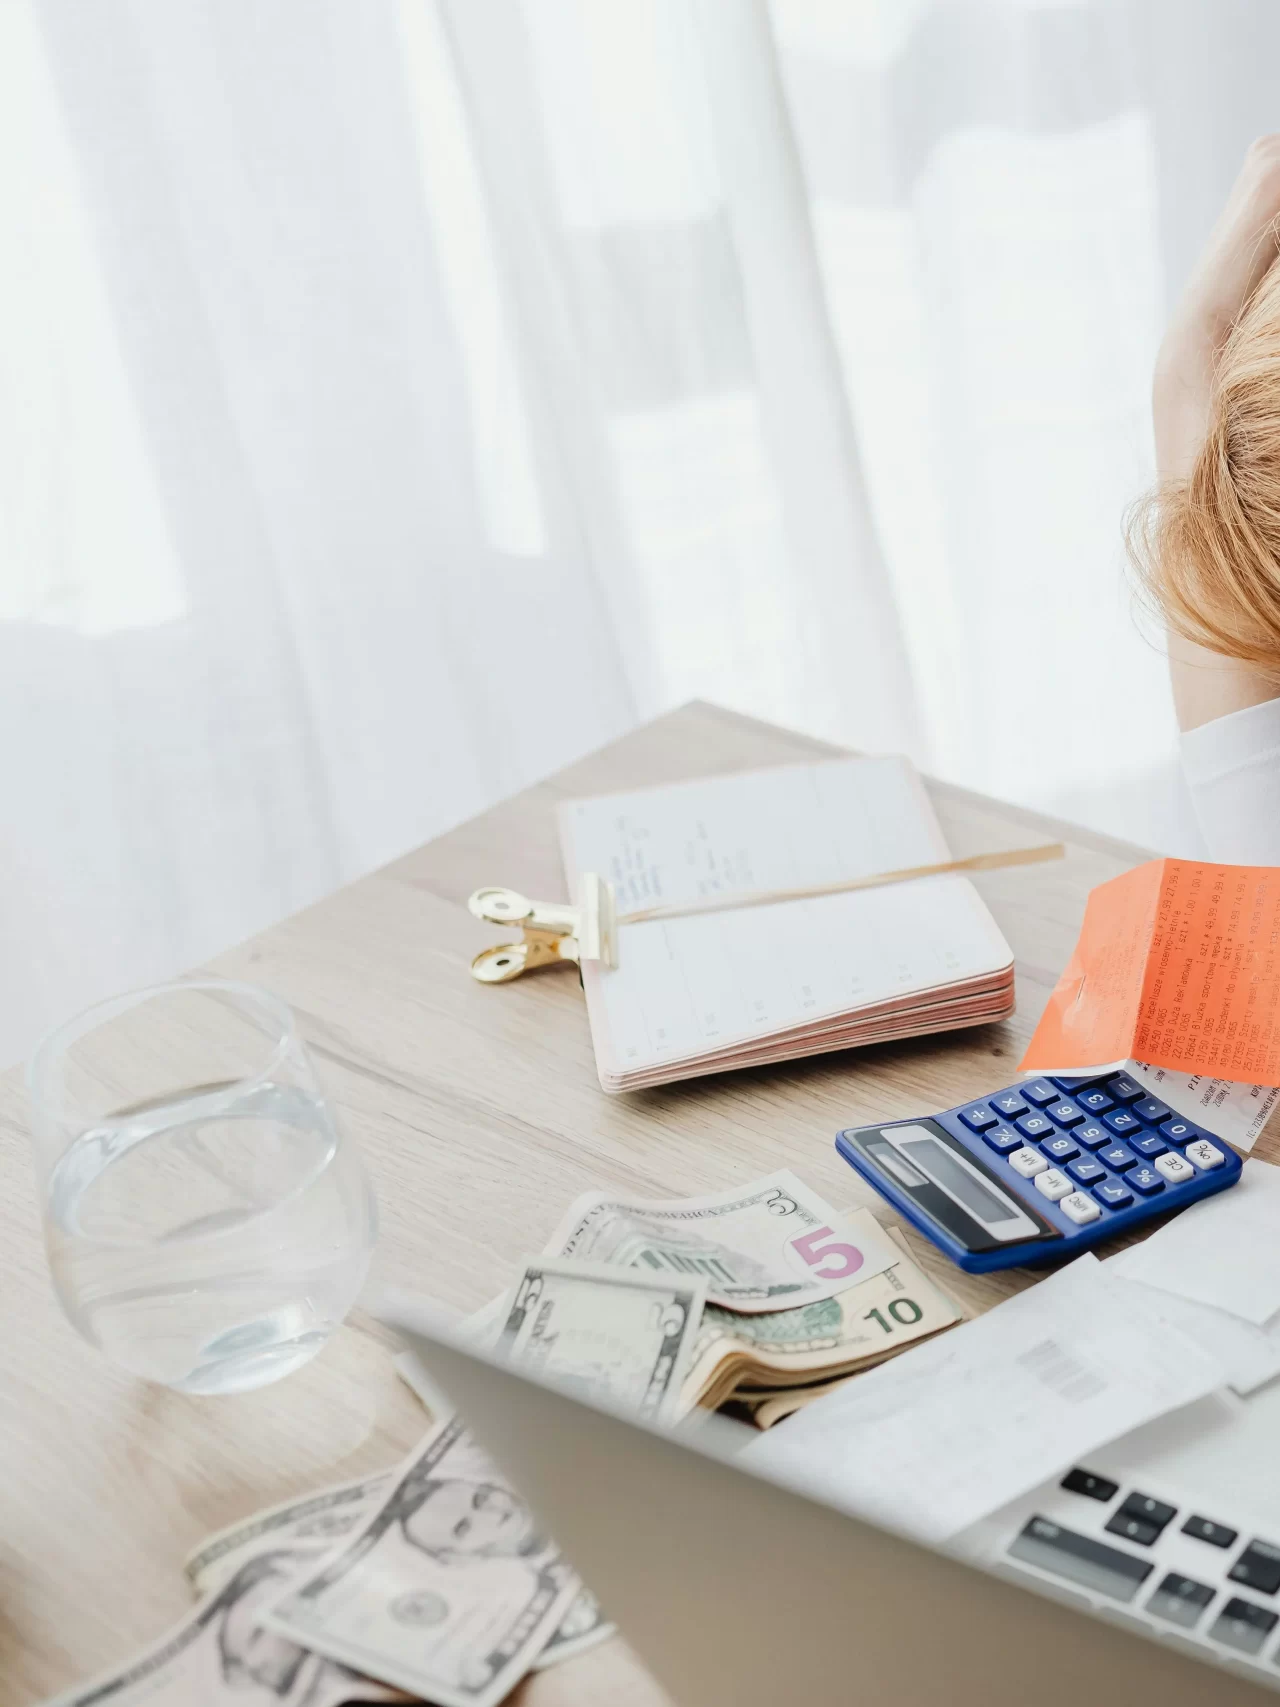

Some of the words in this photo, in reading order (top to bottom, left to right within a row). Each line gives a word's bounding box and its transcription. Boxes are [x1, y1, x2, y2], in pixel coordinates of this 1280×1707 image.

[1224, 982, 1236, 994] do
[1177, 1011, 1192, 1033] 0065
[1088, 1094, 1104, 1104] 3
[1115, 1114, 1132, 1124] 2
[1082, 1128, 1100, 1137] 5
[1052, 1140, 1068, 1149] 8
[1109, 1149, 1124, 1158] 4
[1077, 1164, 1095, 1173] 7
[1165, 1158, 1184, 1171] CE
[791, 1226, 865, 1280] 5
[863, 1298, 924, 1334] 10
